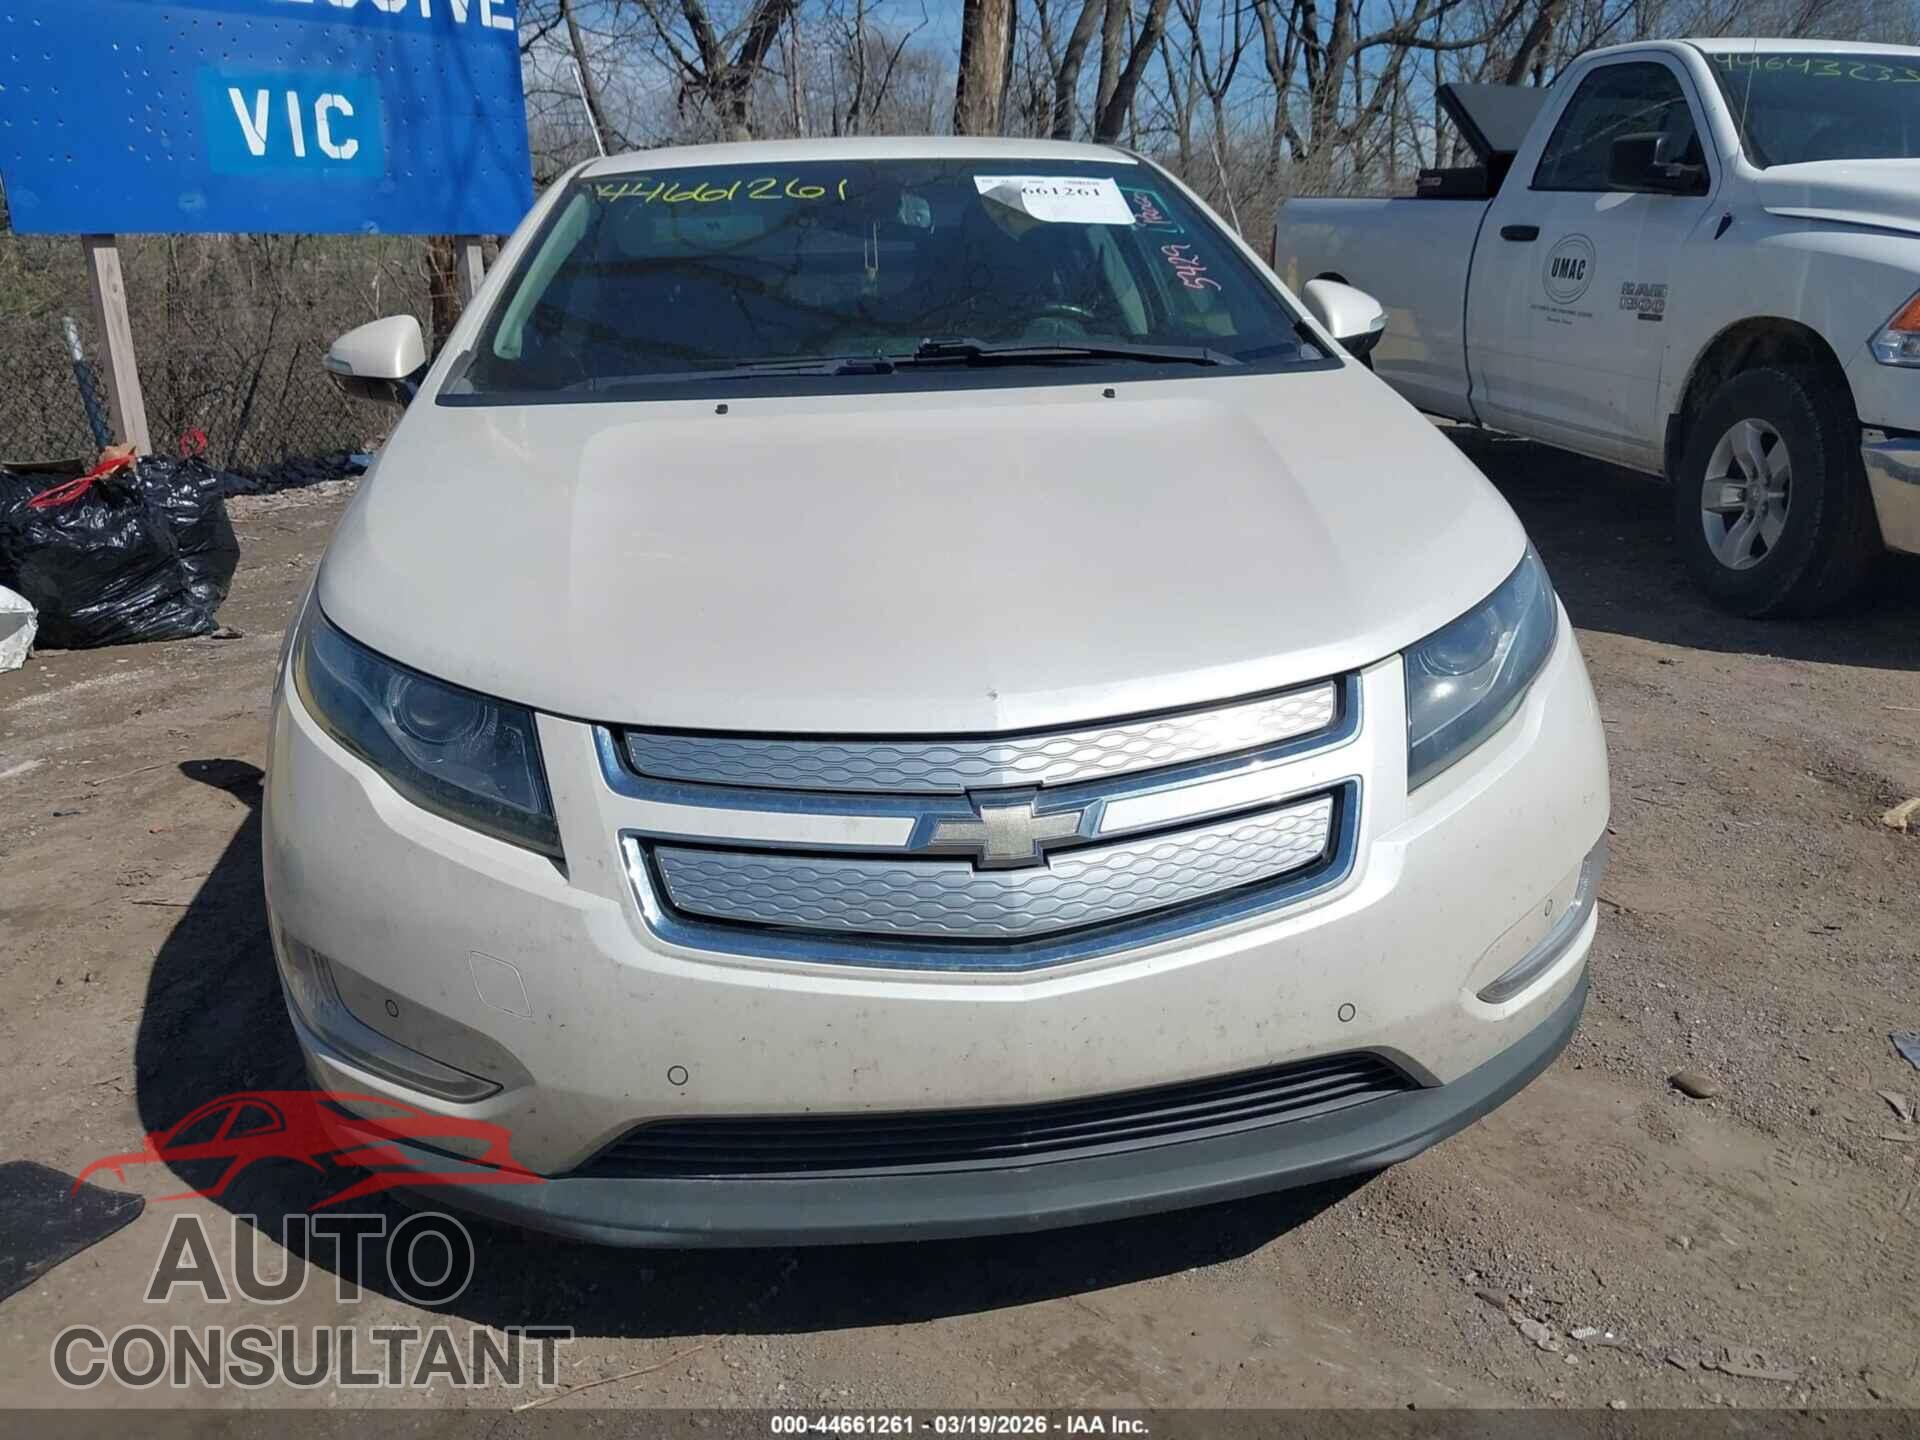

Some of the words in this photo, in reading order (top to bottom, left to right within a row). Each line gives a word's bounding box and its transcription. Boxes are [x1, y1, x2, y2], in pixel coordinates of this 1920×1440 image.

[228, 87, 360, 160] VIC
[595, 177, 849, 203] 44661261
[1551, 257, 1587, 281] UMAC
